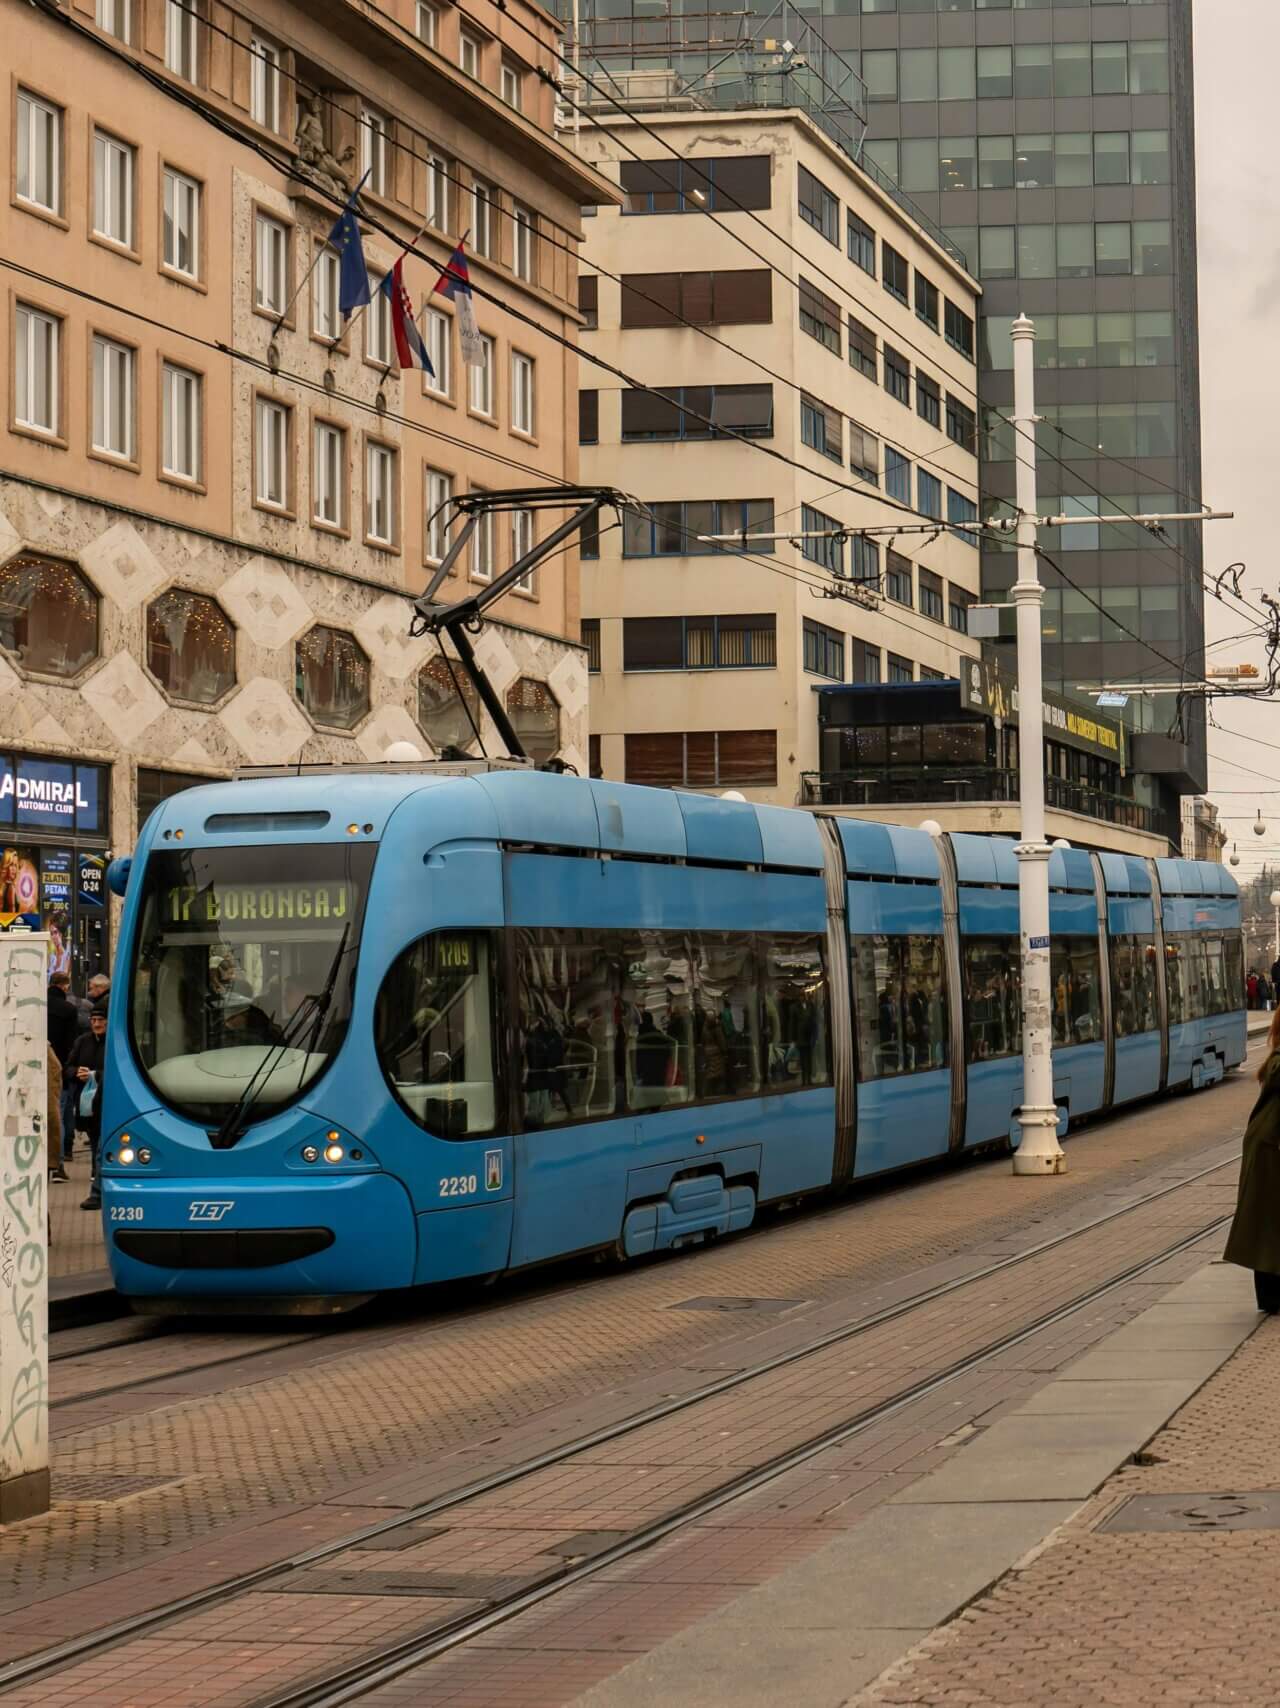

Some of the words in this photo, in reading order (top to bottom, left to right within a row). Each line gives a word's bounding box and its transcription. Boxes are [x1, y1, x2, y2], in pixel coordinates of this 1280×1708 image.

[0, 773, 88, 807] ADMIRAL
[18, 800, 53, 812] AUTOMAT
[55, 804, 74, 814] CLUB
[81, 868, 101, 880] OPEN
[44, 885, 67, 895] PETAK
[83, 881, 99, 892] 0-24
[168, 887, 196, 921] 17
[206, 888, 347, 921] BORONGAJ
[439, 1174, 477, 1197] 2230
[110, 1206, 144, 1221] 2230
[188, 1200, 235, 1221] ZET
